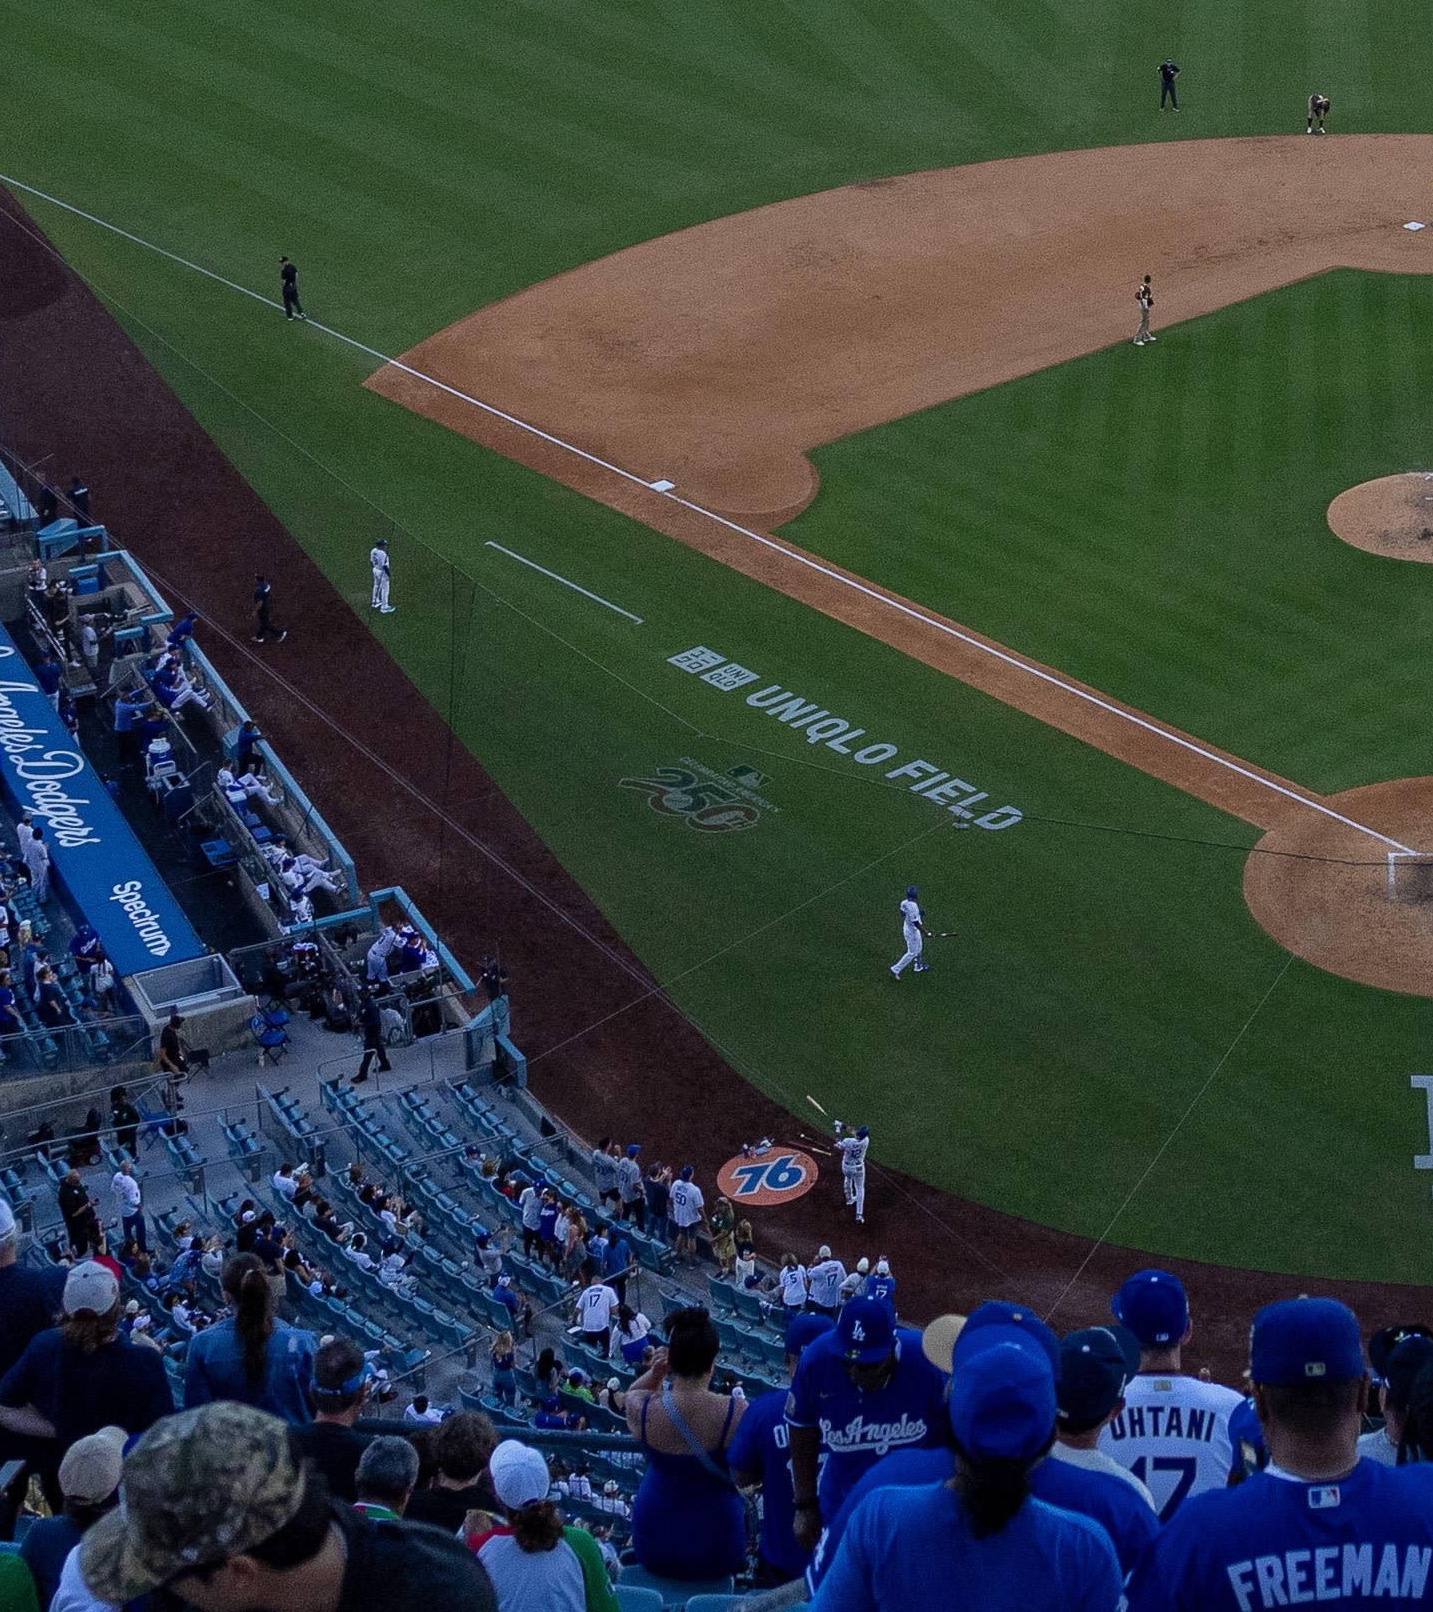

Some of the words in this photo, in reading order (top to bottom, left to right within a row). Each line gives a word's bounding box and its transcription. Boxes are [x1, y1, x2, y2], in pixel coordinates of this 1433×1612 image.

[709, 672, 737, 688] QLO
[723, 665, 751, 682] UNI
[746, 684, 899, 765] UNIQLO
[885, 759, 1025, 831] FIELD
[9, 749, 100, 848] Dodgers
[109, 880, 171, 957] Spectrum
[732, 1154, 807, 1197] 76
[675, 1192, 687, 1206] 50
[789, 1273, 798, 1284] 5
[827, 1273, 838, 1286] 17
[588, 1293, 601, 1308] 17
[852, 1320, 866, 1342] LA
[846, 1412, 928, 1448] Angeles
[1109, 1406, 1216, 1443] OHTANI
[1226, 1543, 1433, 1612] FREEMAN
